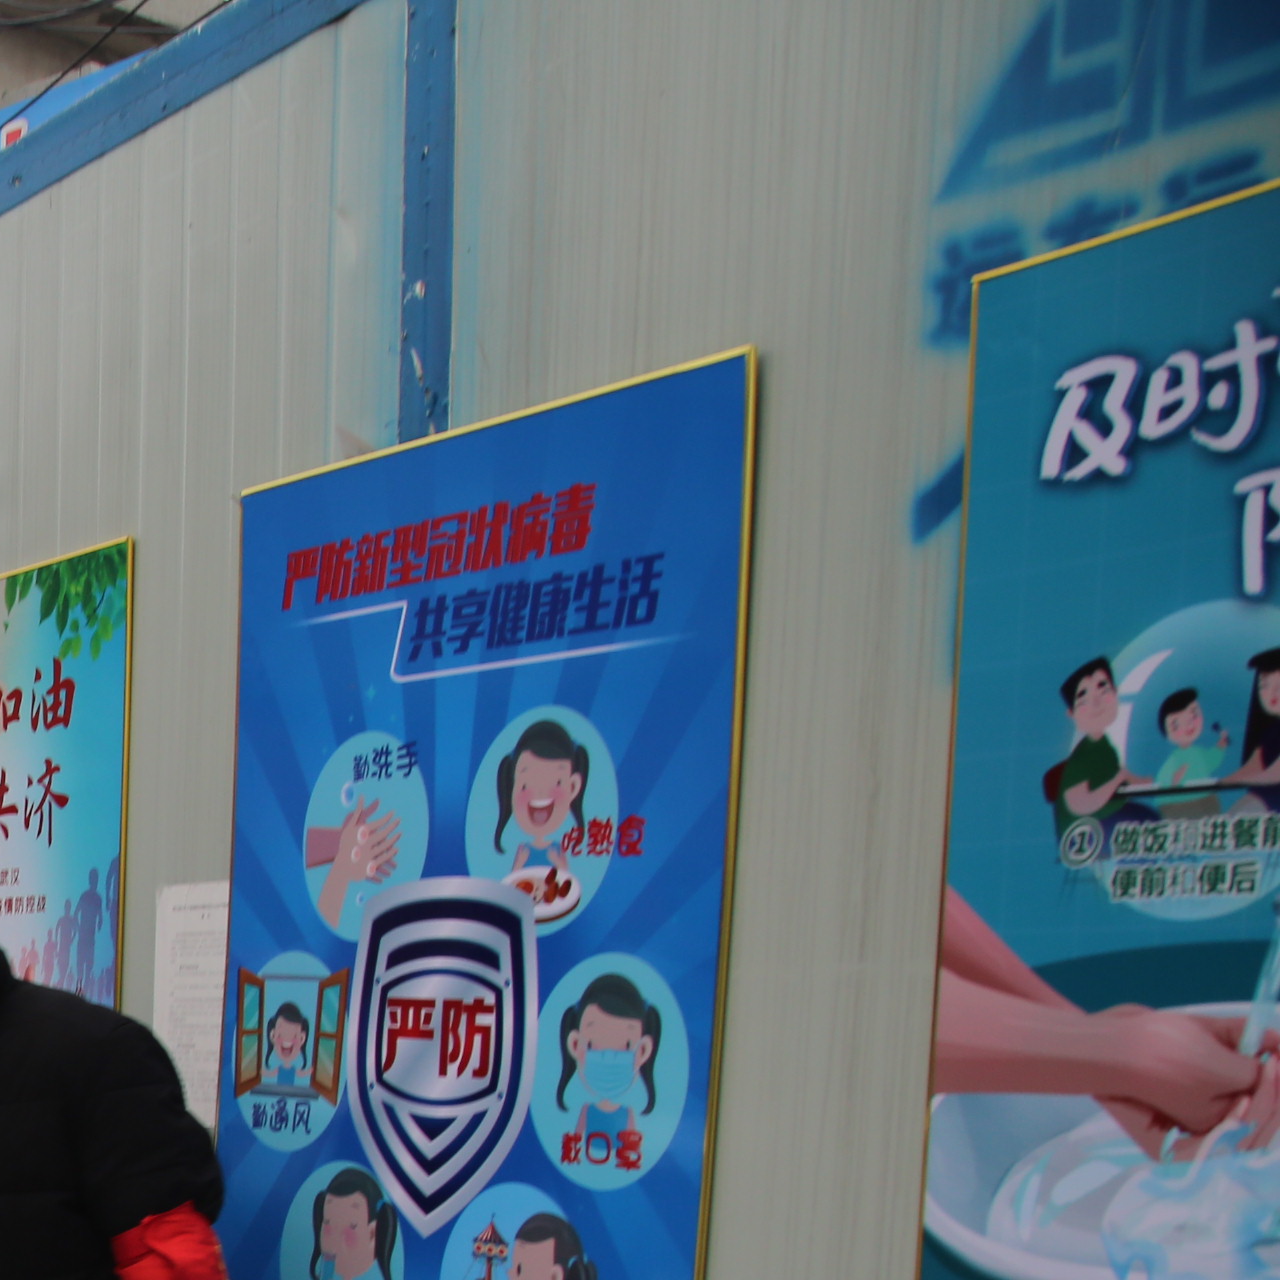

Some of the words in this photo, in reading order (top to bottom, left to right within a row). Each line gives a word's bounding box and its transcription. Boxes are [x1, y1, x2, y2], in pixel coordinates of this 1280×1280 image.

[1040, 316, 1280, 483] 及时
[281, 483, 596, 611] 严防新型冠状病毒
[407, 552, 665, 663] 共享健康生活
[353, 741, 419, 783] 勤洗手
[562, 816, 647, 857] 吃熟食
[1112, 860, 1258, 899] 便前和便后
[384, 997, 495, 1079] 严防
[252, 1101, 312, 1136] 勤通风
[561, 1132, 642, 1171] 戴口罩
